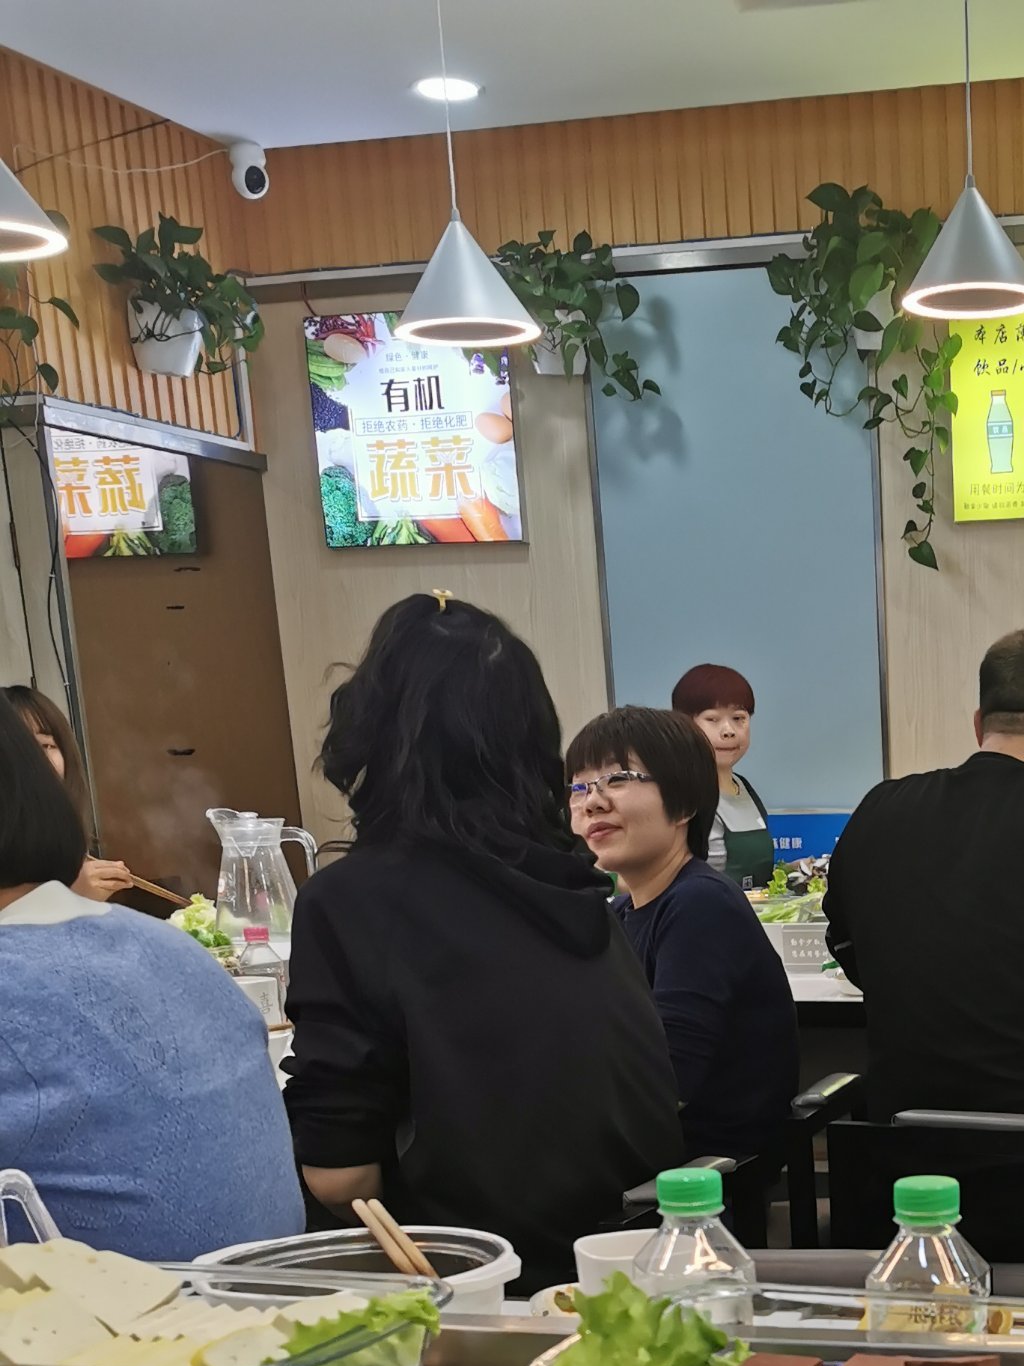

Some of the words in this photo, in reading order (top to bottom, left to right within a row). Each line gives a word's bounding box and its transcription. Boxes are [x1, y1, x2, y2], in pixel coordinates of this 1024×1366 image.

[380, 375, 445, 413] 有机
[362, 414, 468, 433] 拒绝农药·拒绝化肥
[366, 435, 475, 501] 蔬菜
